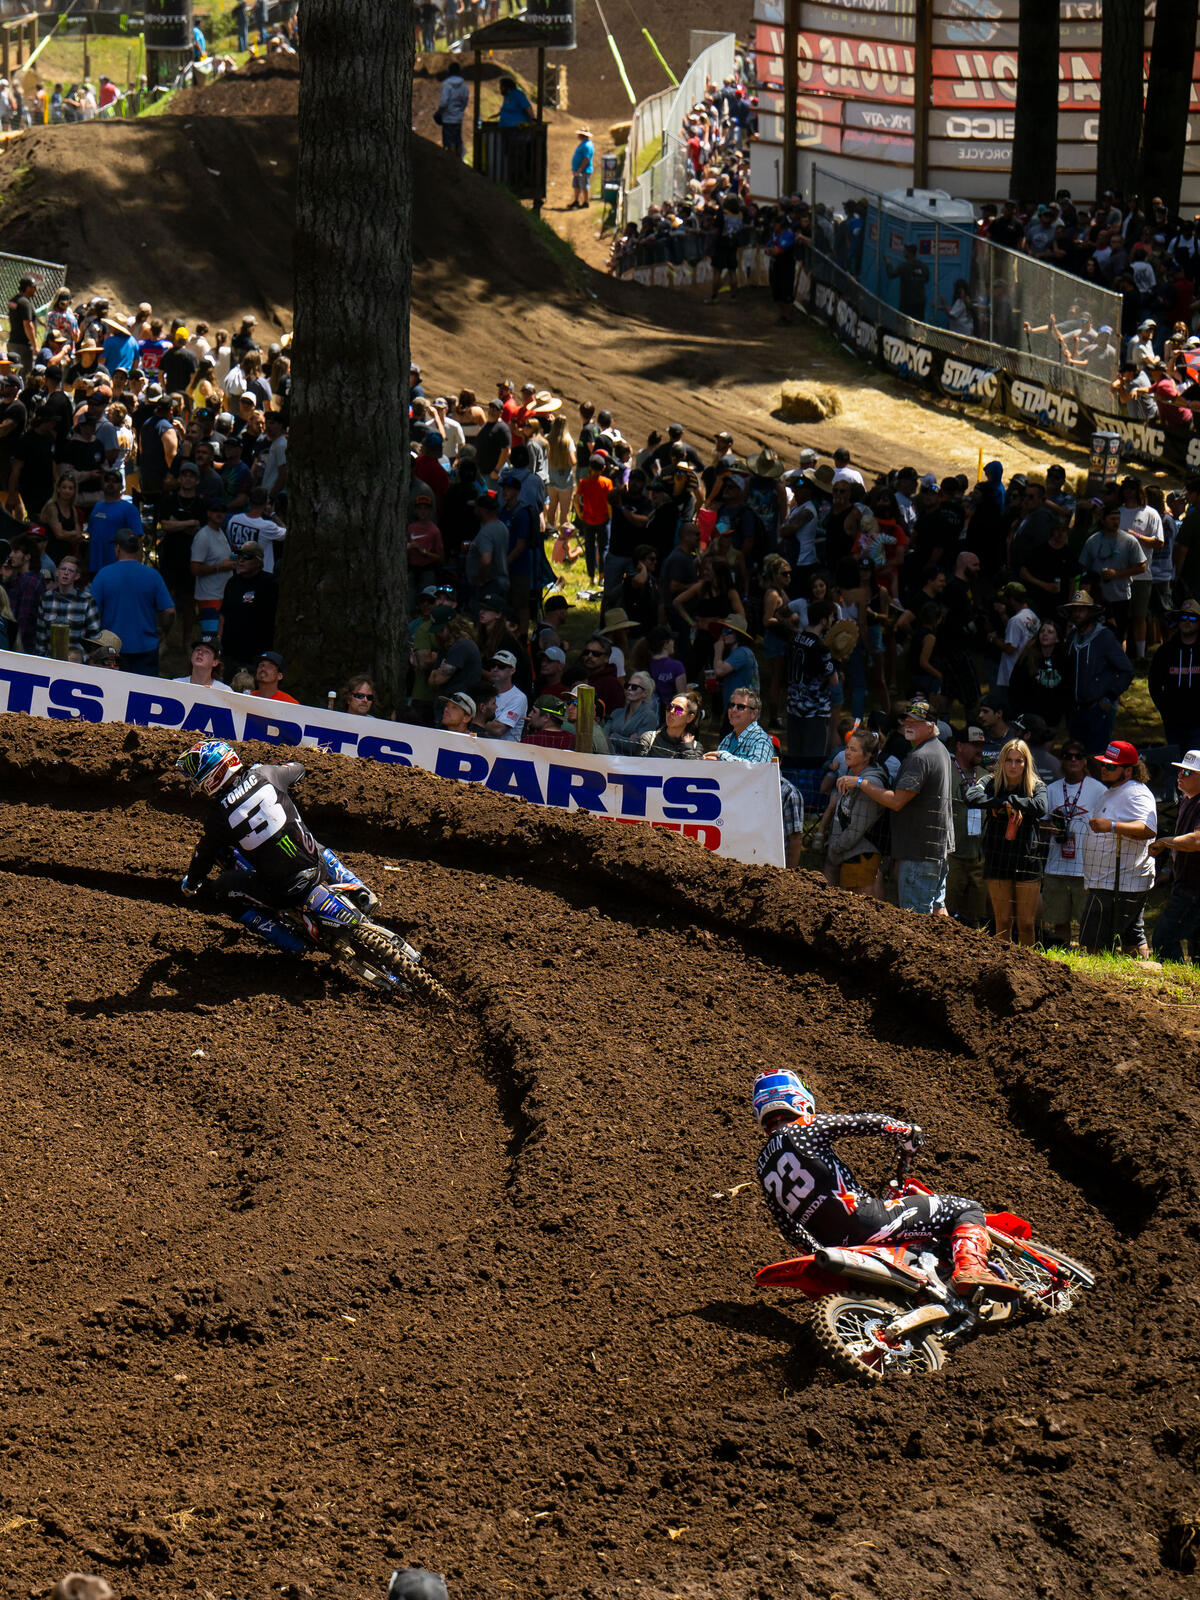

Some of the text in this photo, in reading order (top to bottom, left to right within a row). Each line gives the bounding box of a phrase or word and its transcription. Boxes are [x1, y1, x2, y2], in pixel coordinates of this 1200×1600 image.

[883, 334, 933, 377] STACYC
[941, 358, 999, 399] STACYC
[1011, 380, 1079, 429] STACYC
[221, 774, 258, 809] TOMAC
[435, 747, 722, 821] PARTS
[228, 783, 287, 851] 3
[757, 1134, 783, 1175] SEXTON
[763, 1151, 815, 1216] 23
[800, 1194, 828, 1226] HONDA
